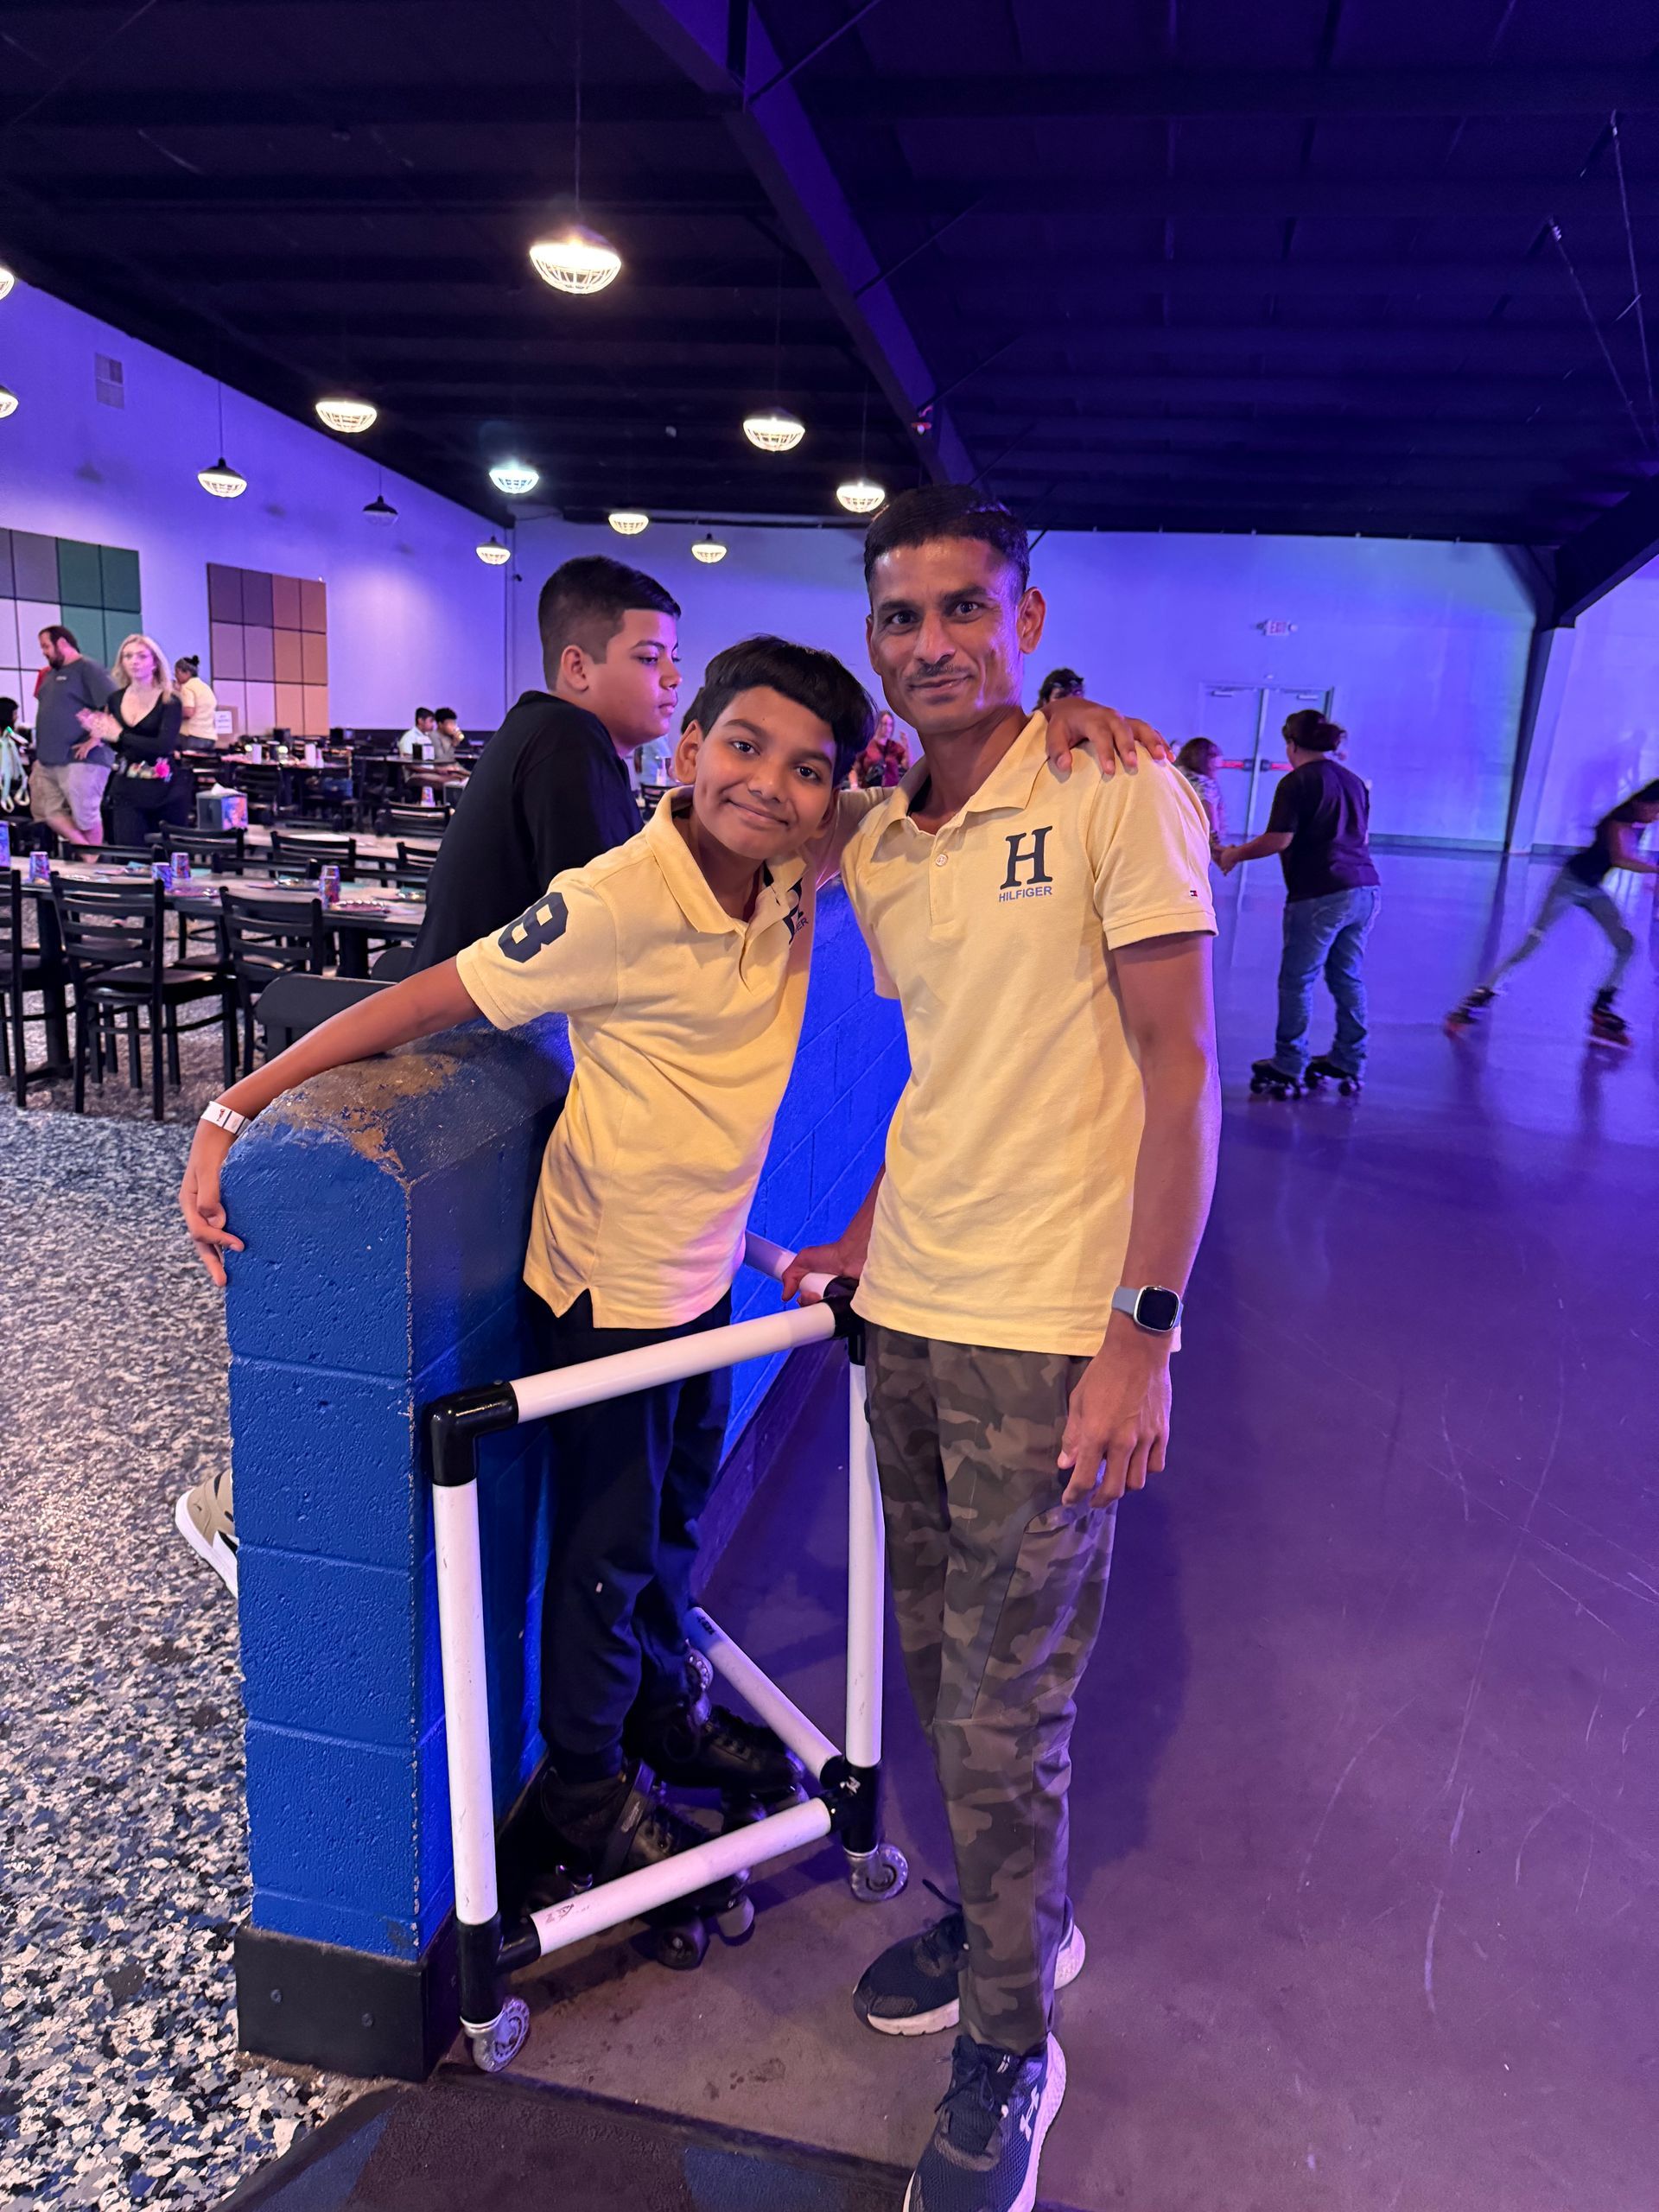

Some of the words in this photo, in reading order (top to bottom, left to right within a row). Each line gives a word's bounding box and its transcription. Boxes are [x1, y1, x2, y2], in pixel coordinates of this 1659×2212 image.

[1000, 825, 1052, 890] H
[999, 886, 1052, 902] HILFIGER
[498, 892, 569, 963] 8
